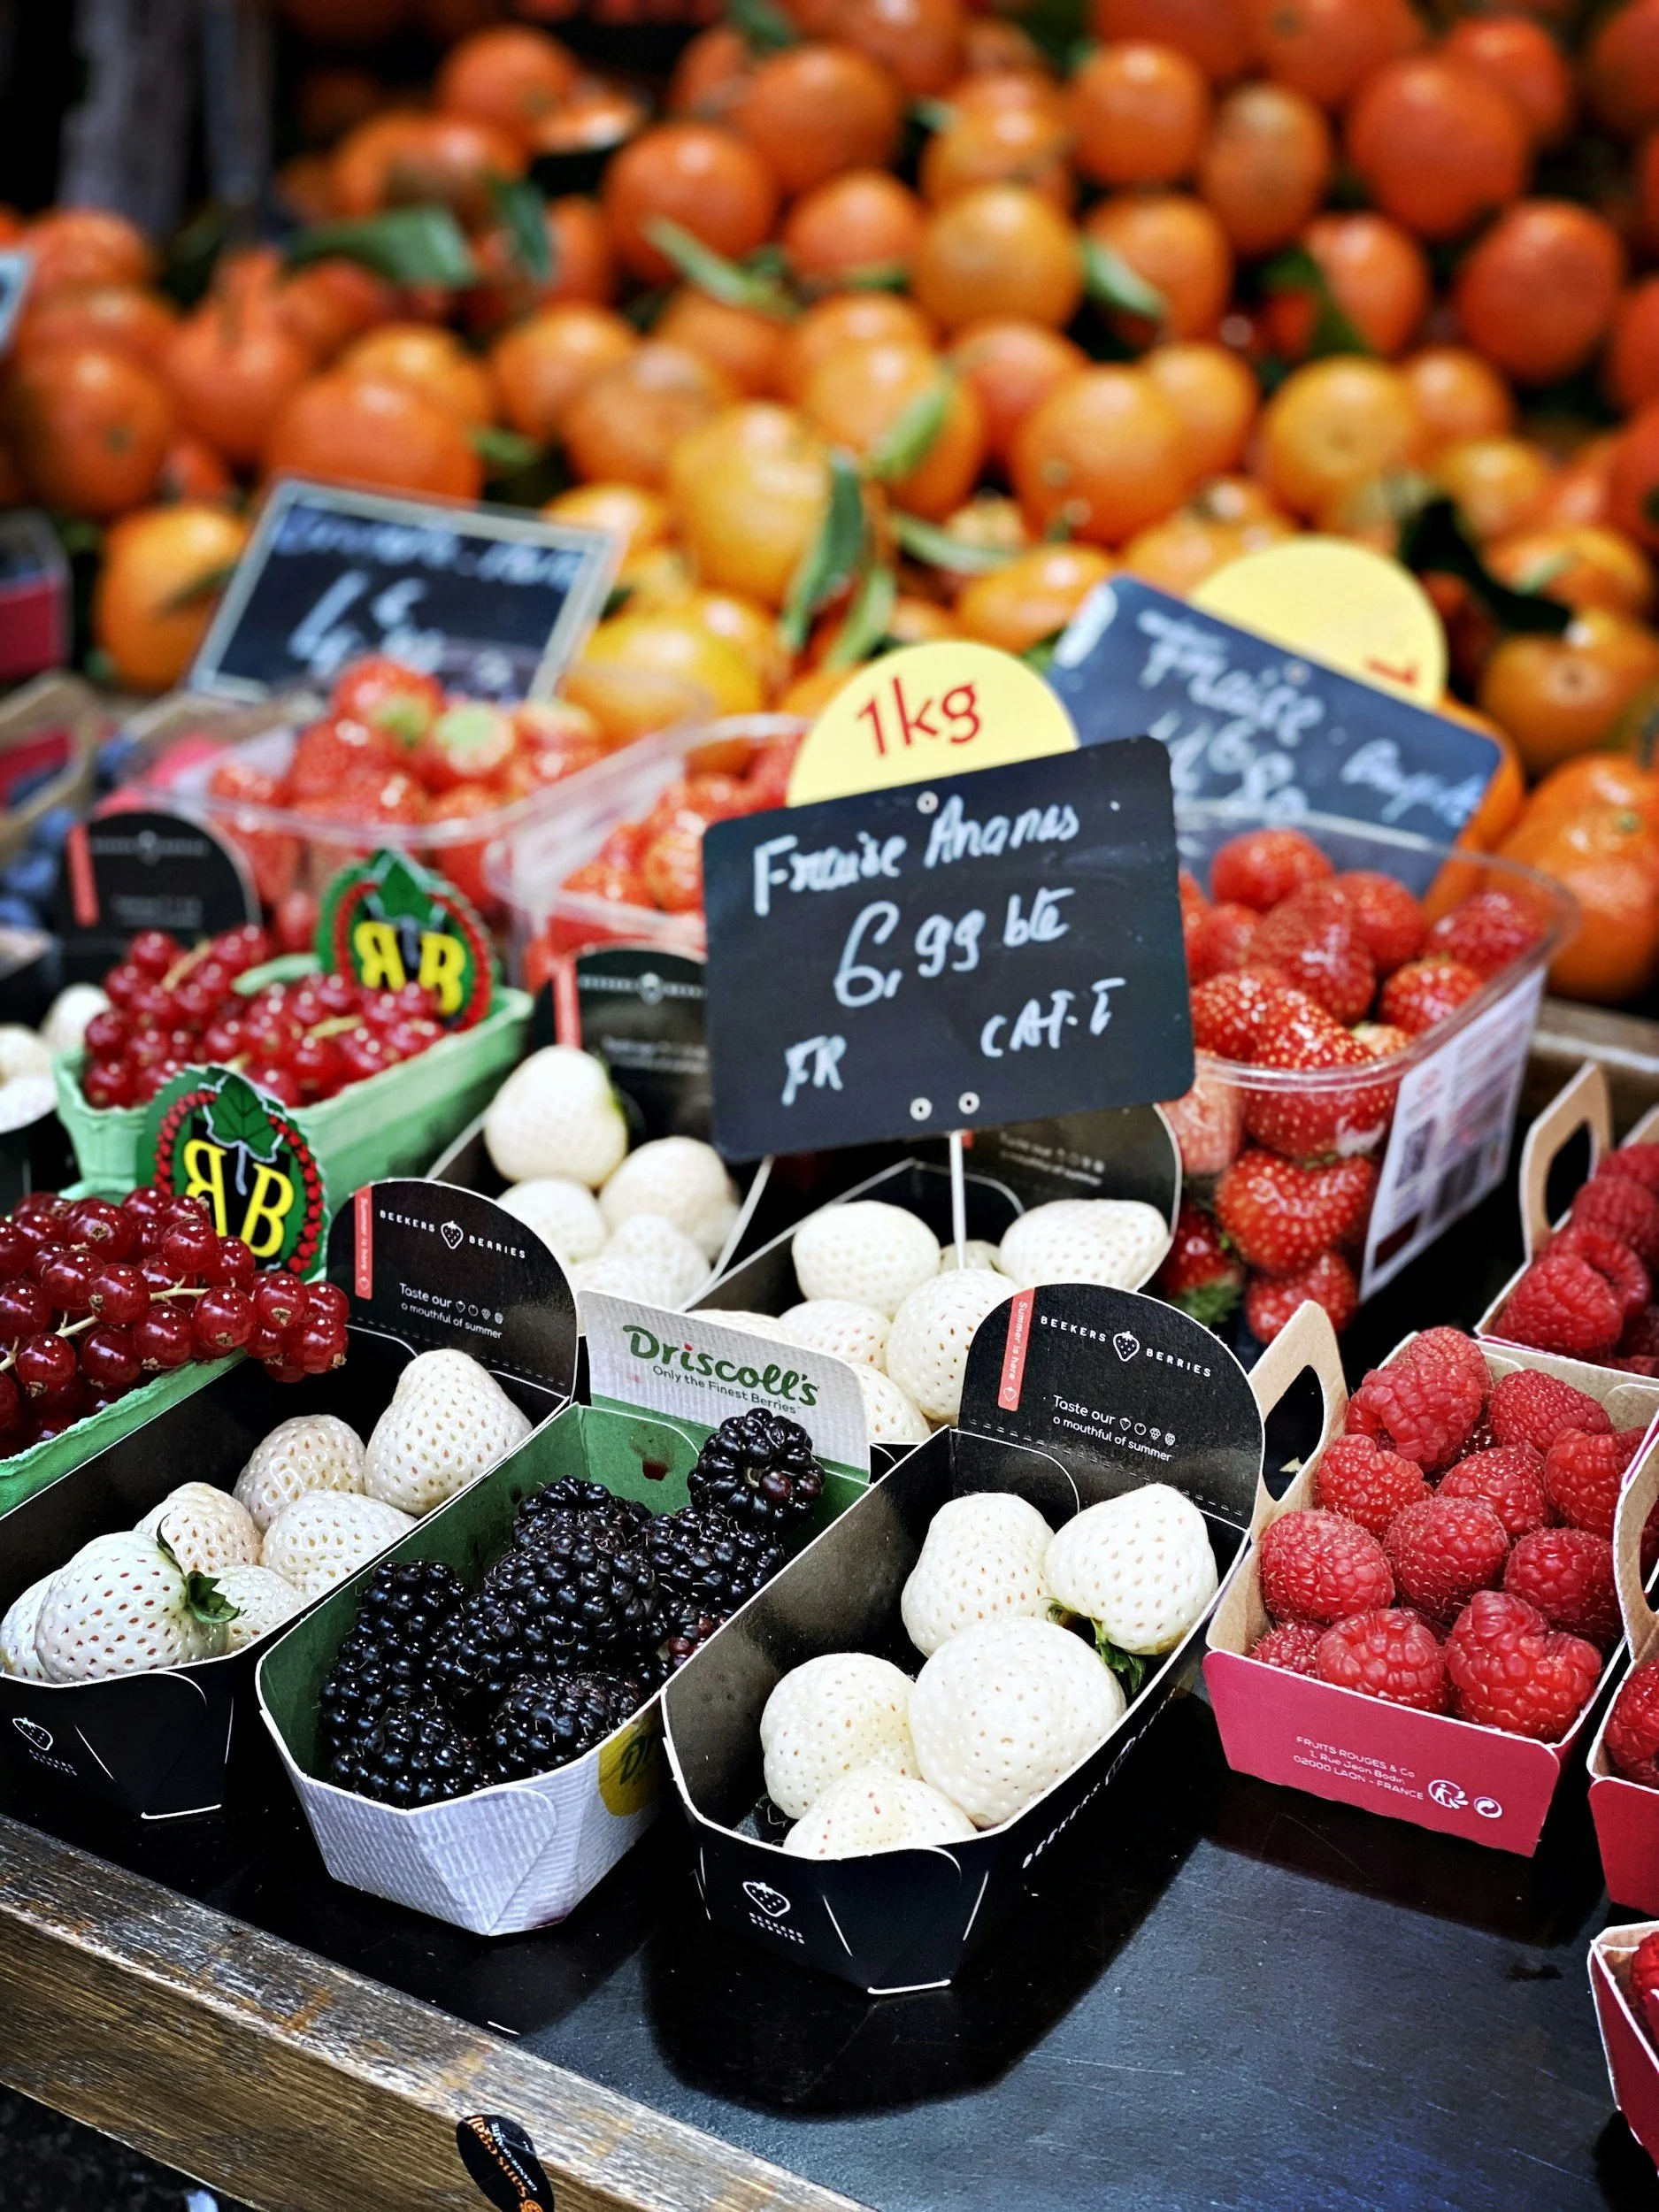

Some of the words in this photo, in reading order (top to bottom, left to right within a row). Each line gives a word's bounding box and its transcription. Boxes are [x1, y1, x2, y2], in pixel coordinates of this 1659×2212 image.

[857, 678, 979, 755] 1kg
[781, 1034, 847, 1106] FR
[380, 1210, 435, 1233] BEEKERS
[469, 1235, 526, 1259] BERRIES
[399, 1282, 429, 1302] Taste
[432, 1296, 452, 1309] our
[410, 1304, 451, 1324] mouthful
[453, 1317, 465, 1328] of
[465, 1322, 503, 1340] summer
[1014, 1302, 1028, 1344] Summer
[623, 1325, 818, 1406] Driscoll's
[1009, 1356, 1019, 1380] here
[1012, 1345, 1021, 1355] is
[1041, 1315, 1107, 1342] BEEKERS
[1146, 1348, 1212, 1378] BERRIES
[653, 1365, 681, 1383] Only
[684, 1375, 705, 1388] the
[709, 1380, 748, 1401] Finest
[751, 1394, 797, 1414] Berries
[1052, 1394, 1089, 1417] Taste
[1091, 1409, 1117, 1426] our
[1063, 1418, 1113, 1443] mouthful
[1114, 1434, 1127, 1447] of
[1128, 1440, 1172, 1463] summer
[1294, 1755, 1332, 1772] 02000
[1334, 1767, 1366, 1783] LAON
[1377, 1780, 1425, 1801] FRANCE
[1296, 1735, 1337, 1755] FRUITS
[1339, 1748, 1386, 1770] ROUGES
[1400, 1767, 1416, 1778] Co
[1320, 1754, 1341, 1765] Rue
[1343, 1760, 1372, 1775] Jean
